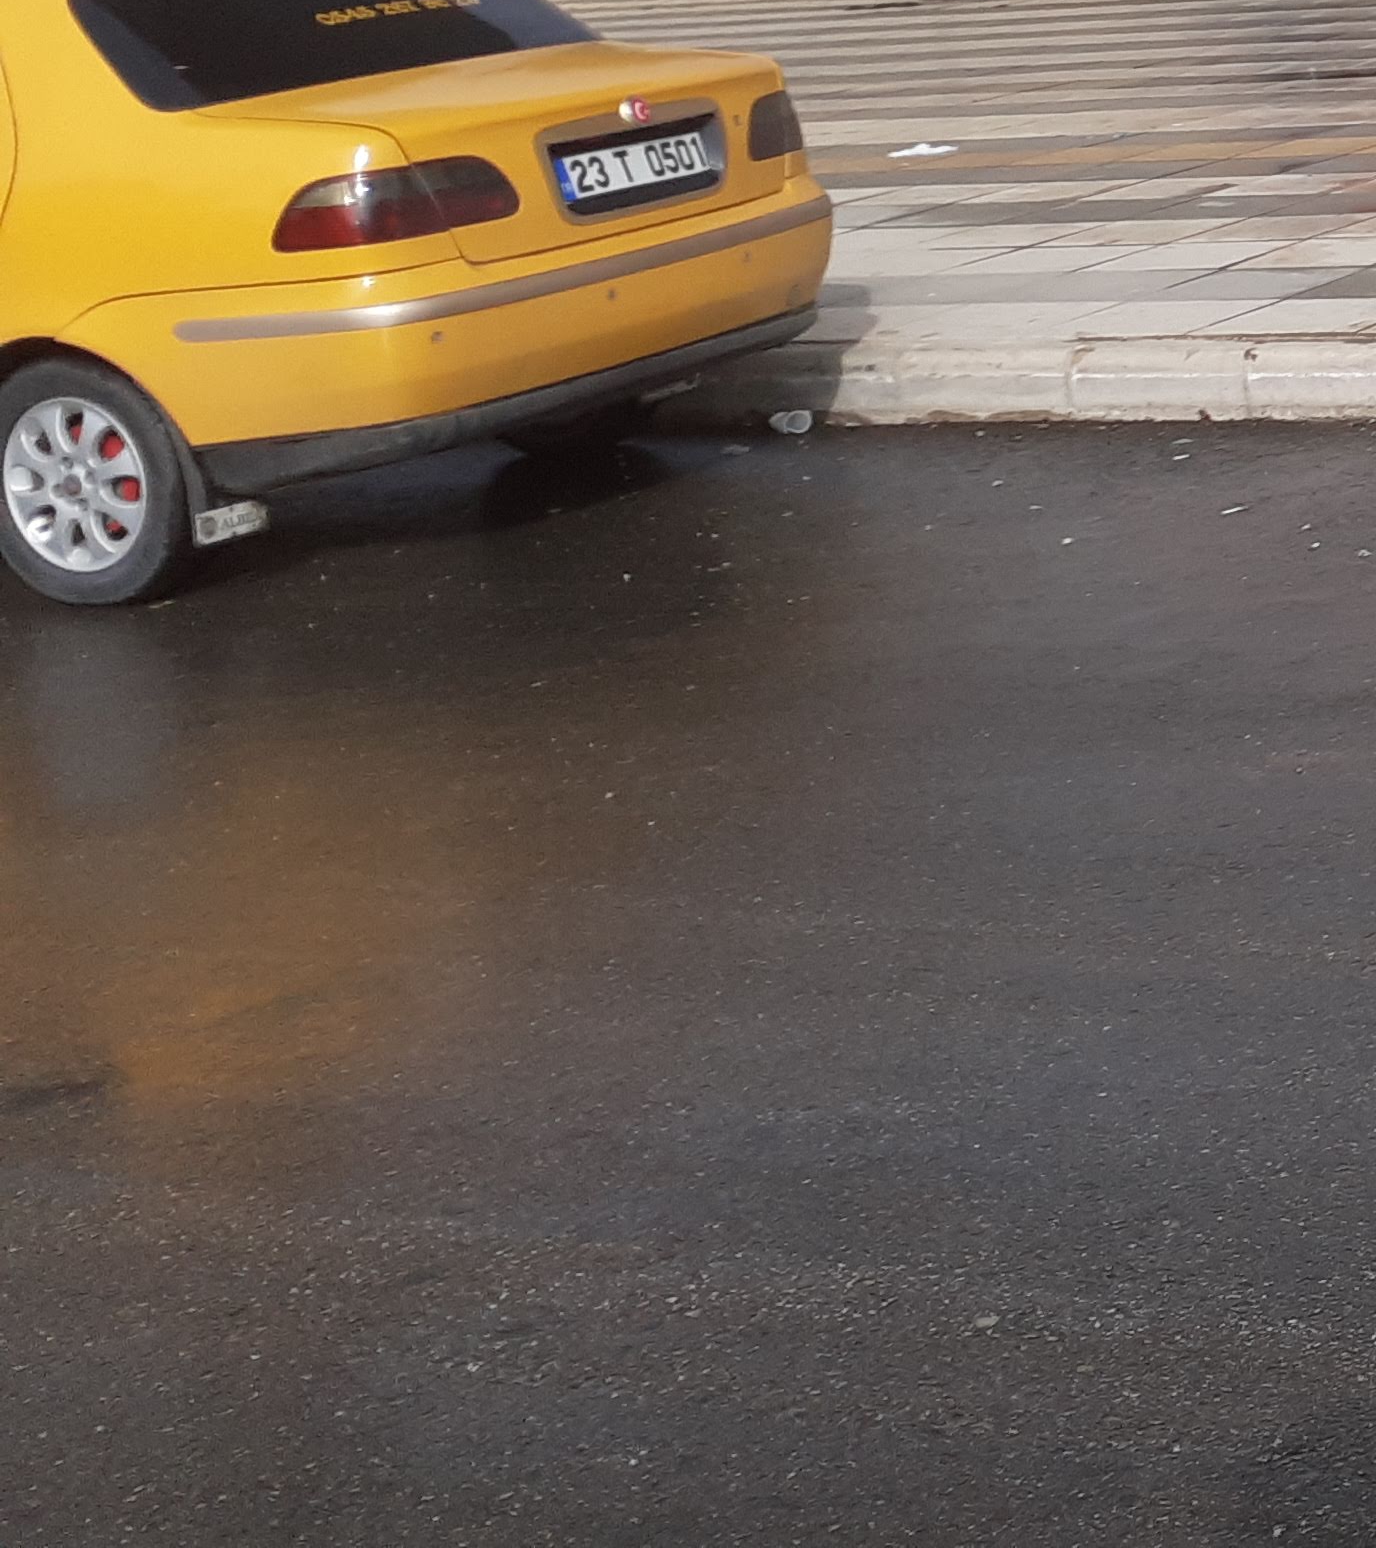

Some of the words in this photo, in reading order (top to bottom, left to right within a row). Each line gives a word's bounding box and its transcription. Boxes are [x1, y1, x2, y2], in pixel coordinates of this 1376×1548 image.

[570, 156, 610, 193] 23
[612, 150, 634, 182] T
[644, 136, 706, 177] 0501
